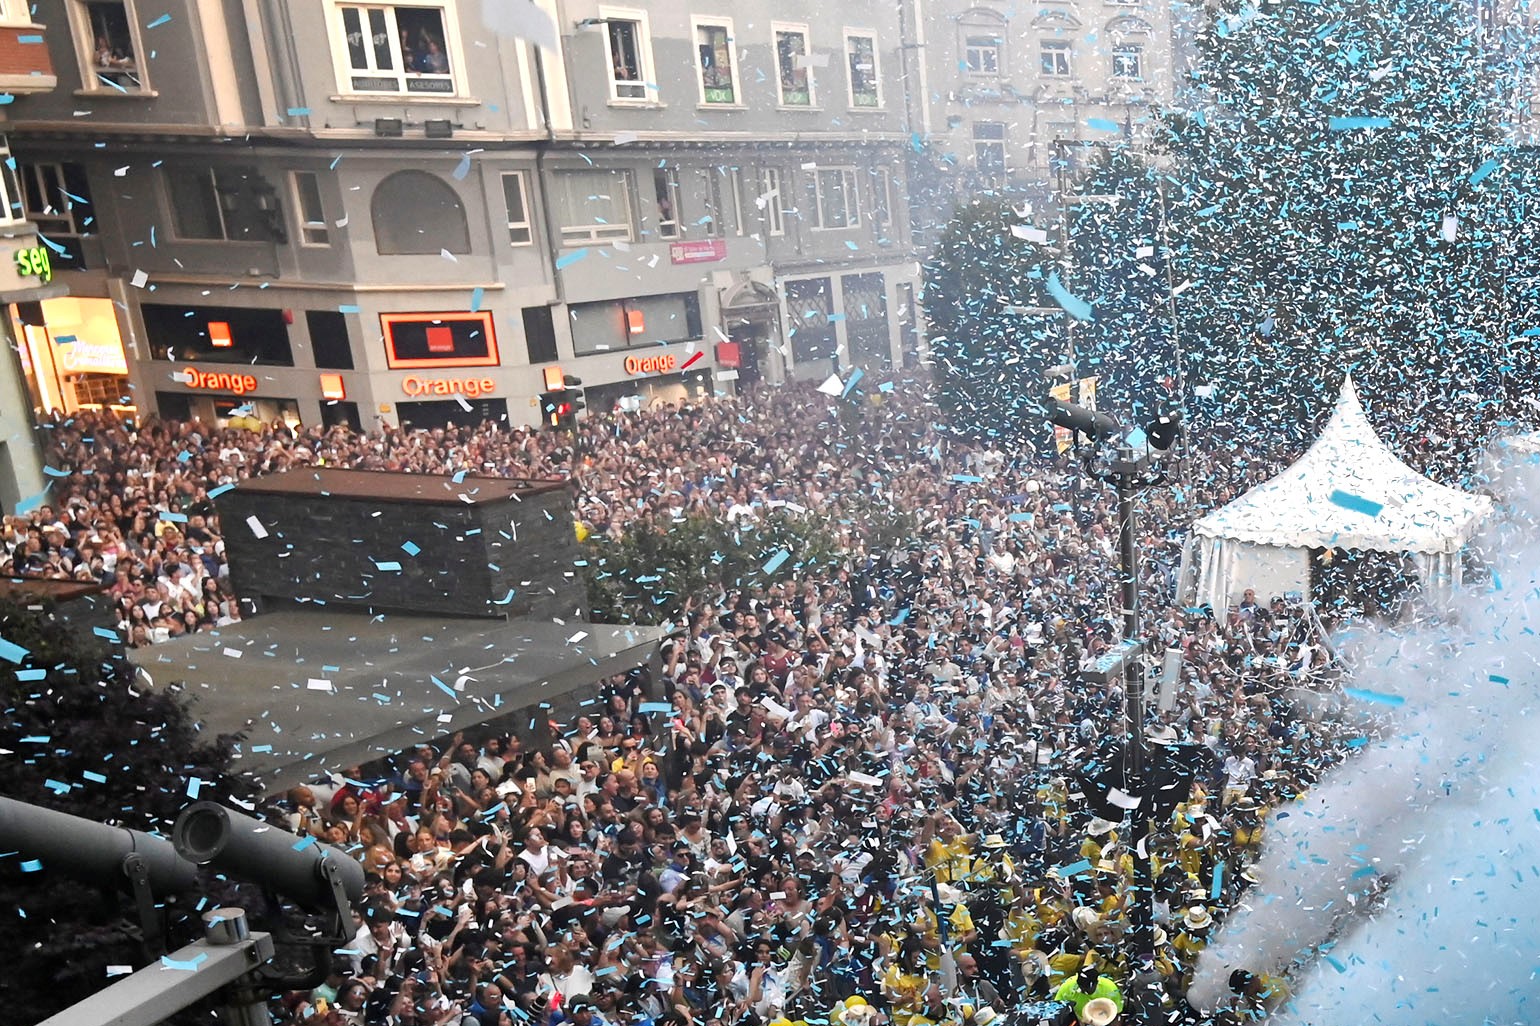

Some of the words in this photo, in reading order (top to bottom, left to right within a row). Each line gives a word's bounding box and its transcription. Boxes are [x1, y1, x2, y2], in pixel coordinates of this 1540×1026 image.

[409, 82, 450, 91] ASESORES
[710, 90, 726, 101] VOX
[17, 247, 51, 281] seg
[622, 353, 677, 376] Orange
[183, 366, 257, 395] Orange
[401, 374, 495, 398] Orange
